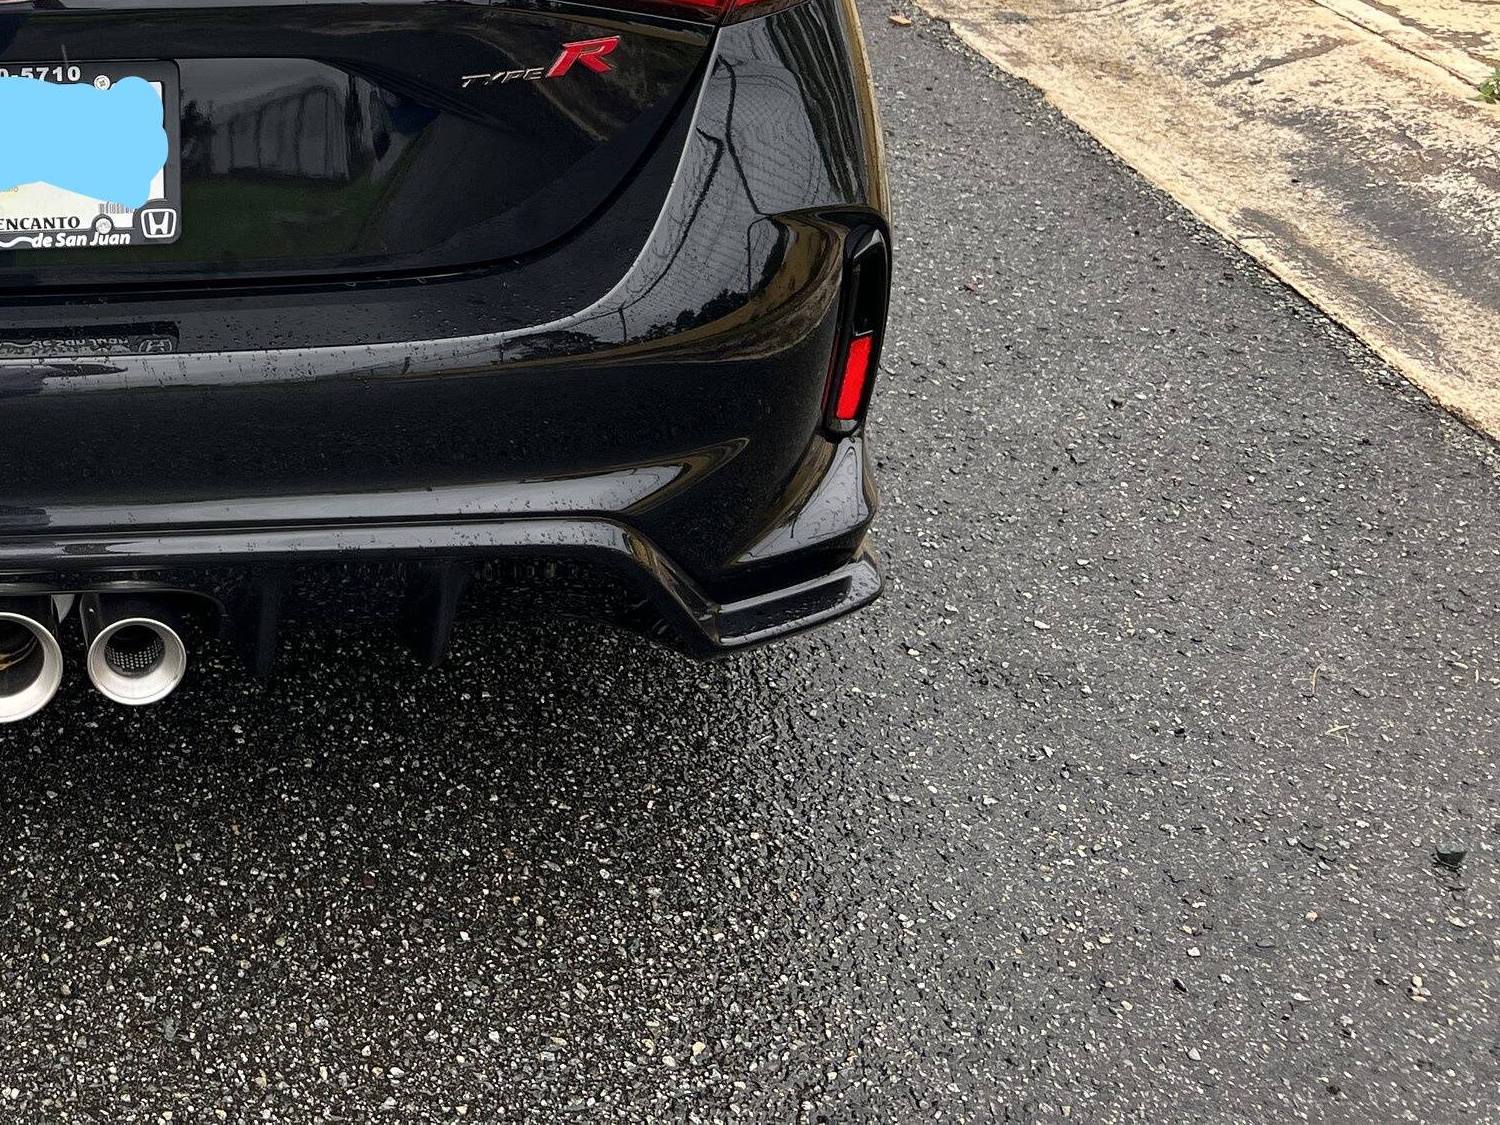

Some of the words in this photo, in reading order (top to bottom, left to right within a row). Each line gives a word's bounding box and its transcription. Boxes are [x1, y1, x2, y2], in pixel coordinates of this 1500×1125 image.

[461, 67, 545, 88] TYPE
[546, 35, 621, 79] R
[31, 232, 53, 248] de
[55, 232, 87, 247] San
[89, 231, 131, 246] Juan
